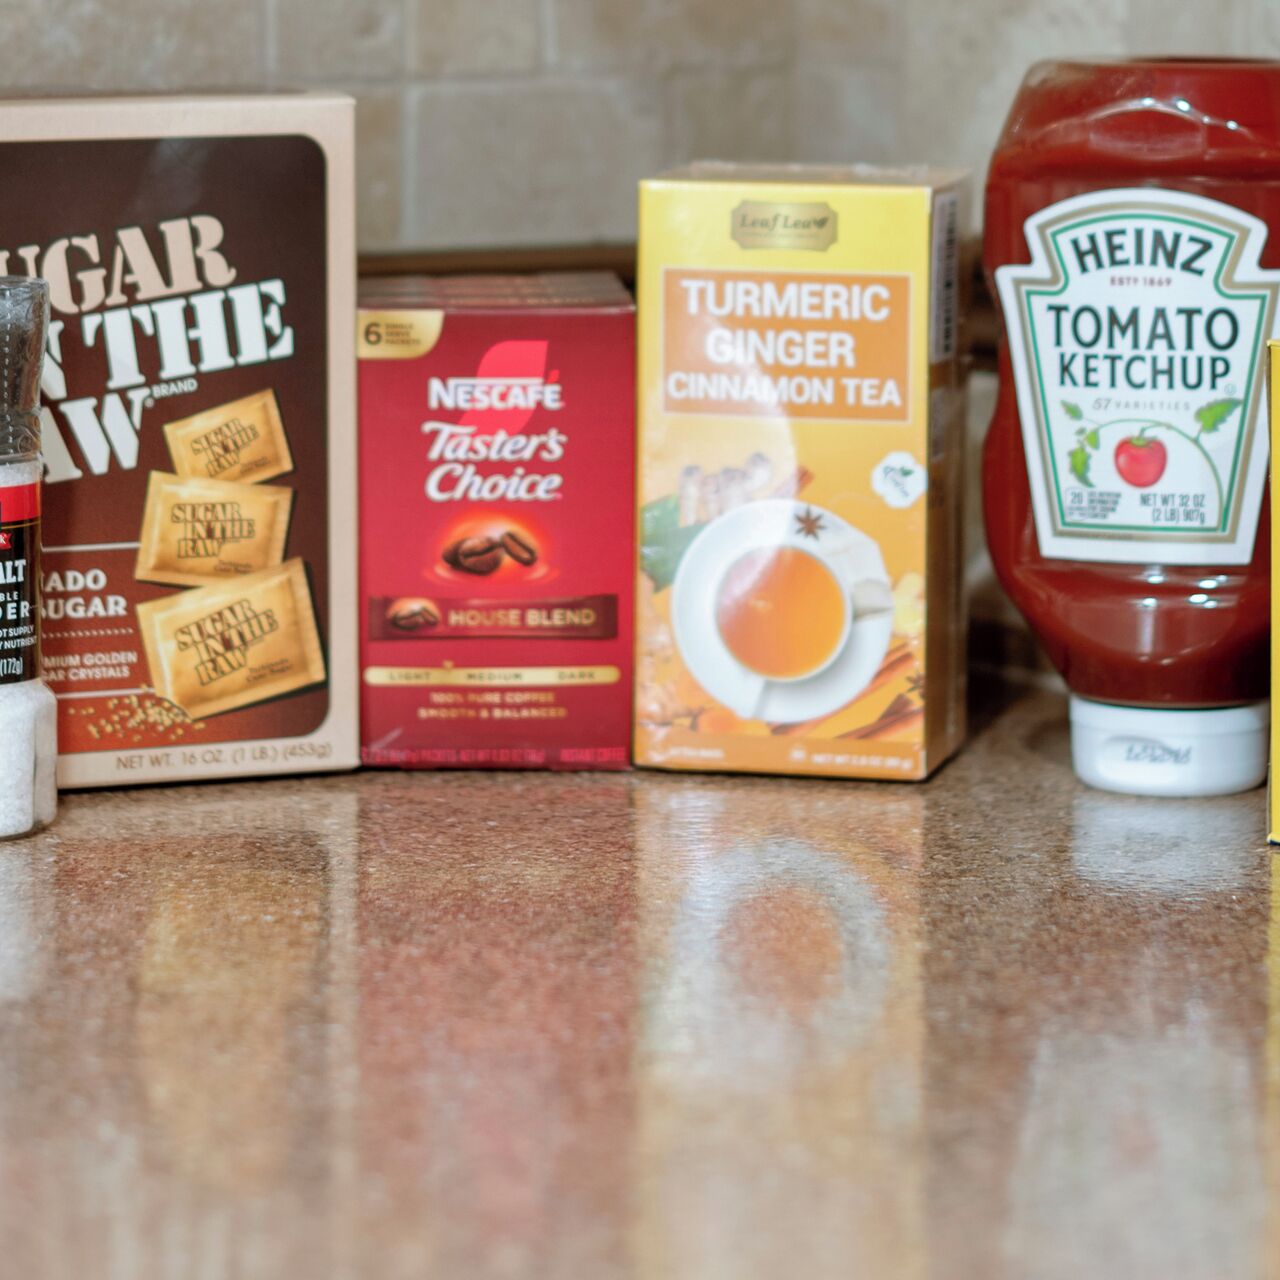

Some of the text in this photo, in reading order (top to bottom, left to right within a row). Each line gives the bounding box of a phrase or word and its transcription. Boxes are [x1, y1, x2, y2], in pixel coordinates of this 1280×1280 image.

[1070, 227, 1214, 277] HEINZ
[1143, 277, 1173, 287] 1869
[680, 278, 891, 322] TURMERIC
[81, 278, 294, 390] THE
[363, 322, 383, 346] 6
[1046, 303, 1240, 352] TOMATO
[705, 326, 856, 368] GINGER
[1059, 351, 1231, 391] KETCHUP
[152, 378, 198, 399] BRAND
[428, 369, 563, 411] NESCAFÉ
[667, 370, 902, 407] CINNAMON TEA
[1091, 397, 1191, 412] 57 VARIETIES
[421, 421, 569, 462] Taster's
[424, 463, 564, 503] Choice
[1139, 493, 1206, 508] NET WT 32 OZ
[171, 502, 242, 523] SUGAR
[1151, 509, 1206, 525] (2 LB) 907g
[210, 519, 256, 539] THE
[177, 538, 223, 559] RAW
[175, 598, 257, 652] SUGAR
[448, 608, 597, 627] HOUSE BLEND
[8, 624, 35, 637] SUPPLY
[226, 609, 279, 650] THE
[4, 635, 37, 649] NUTRIENT
[0, 657, 23, 676] (172g)
[42, 650, 138, 668] MIUM GOLDEN
[195, 643, 249, 687] RAW
[68, 665, 130, 680] CRYSTALS
[388, 671, 596, 682] LIGHT MEDIUM DARK
[430, 692, 555, 704] 100% PURE COFFEE
[417, 708, 476, 719] SMOOTH
[492, 708, 568, 719] BALANCED
[116, 755, 144, 770] NET
[182, 751, 198, 765] 16
[282, 742, 333, 761] (453g)
